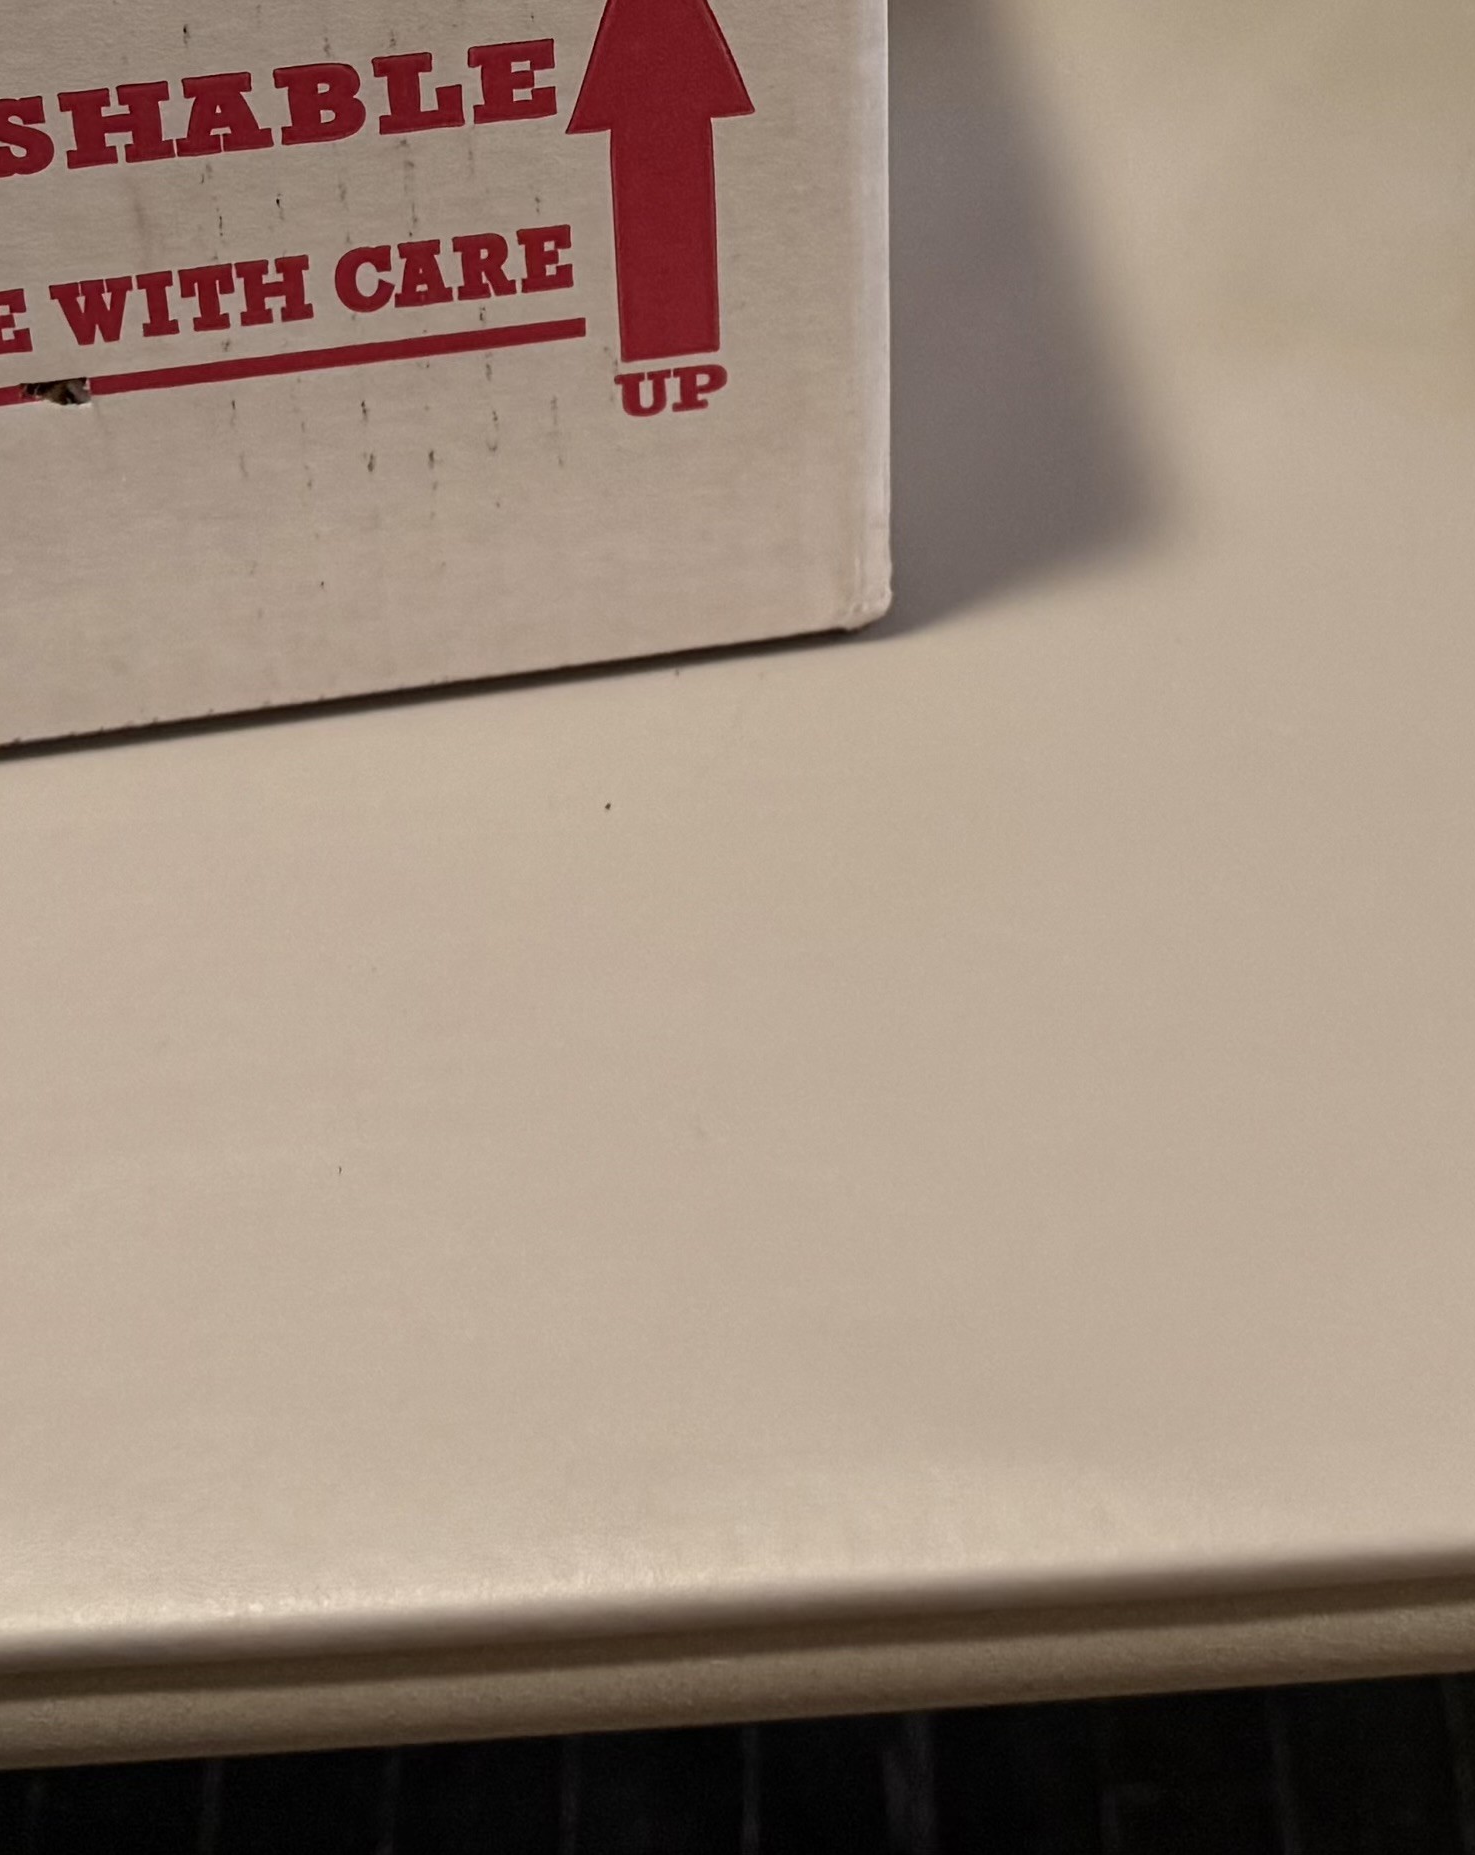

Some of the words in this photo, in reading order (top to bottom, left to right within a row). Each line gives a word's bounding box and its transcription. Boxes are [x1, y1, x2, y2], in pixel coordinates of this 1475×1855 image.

[48, 254, 314, 346] WITH
[333, 223, 575, 313] CARE
[613, 362, 728, 418] UP
